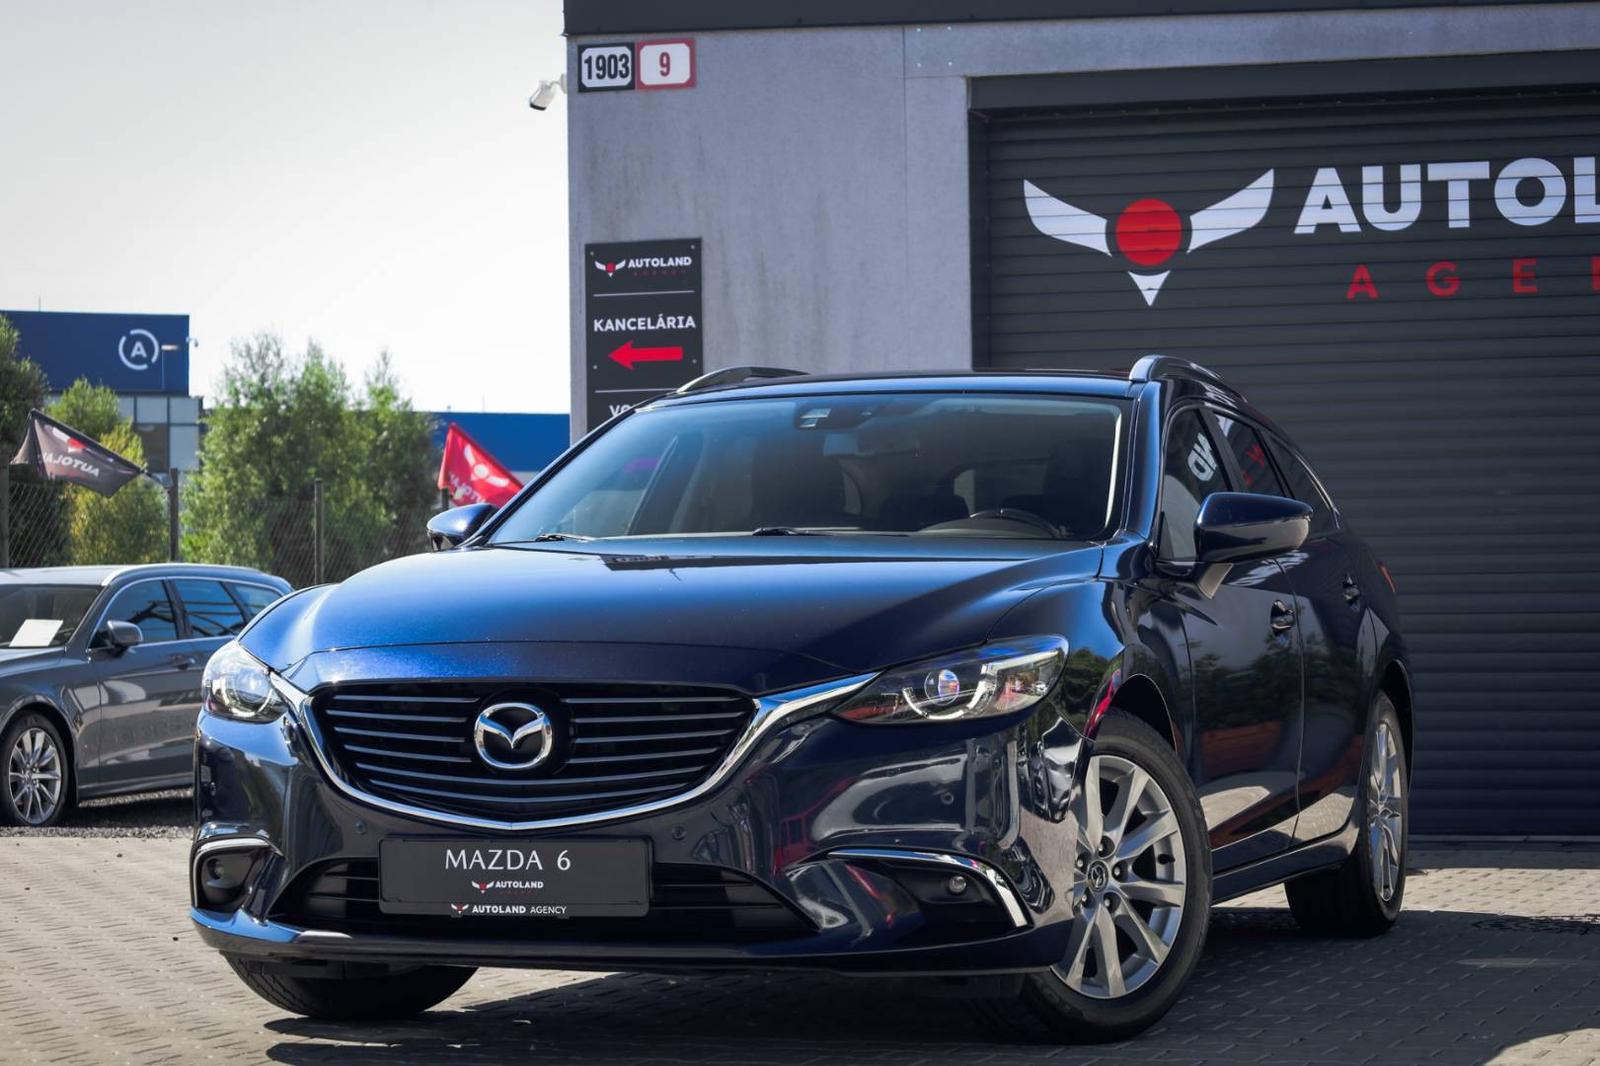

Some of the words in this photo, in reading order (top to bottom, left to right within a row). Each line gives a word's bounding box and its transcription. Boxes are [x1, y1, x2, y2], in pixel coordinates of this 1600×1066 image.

[584, 53, 630, 80] 1903
[659, 51, 671, 77] 9
[1293, 156, 1600, 234] AUTOL
[627, 256, 692, 269] AUTOLAND
[593, 313, 696, 332] KANCELÁRIA
[445, 849, 543, 870] MAZDA
[557, 849, 571, 871] 6
[495, 881, 544, 889] AUTOLAND
[472, 904, 526, 914] AUTOLAND
[530, 906, 567, 914] AGENCY
